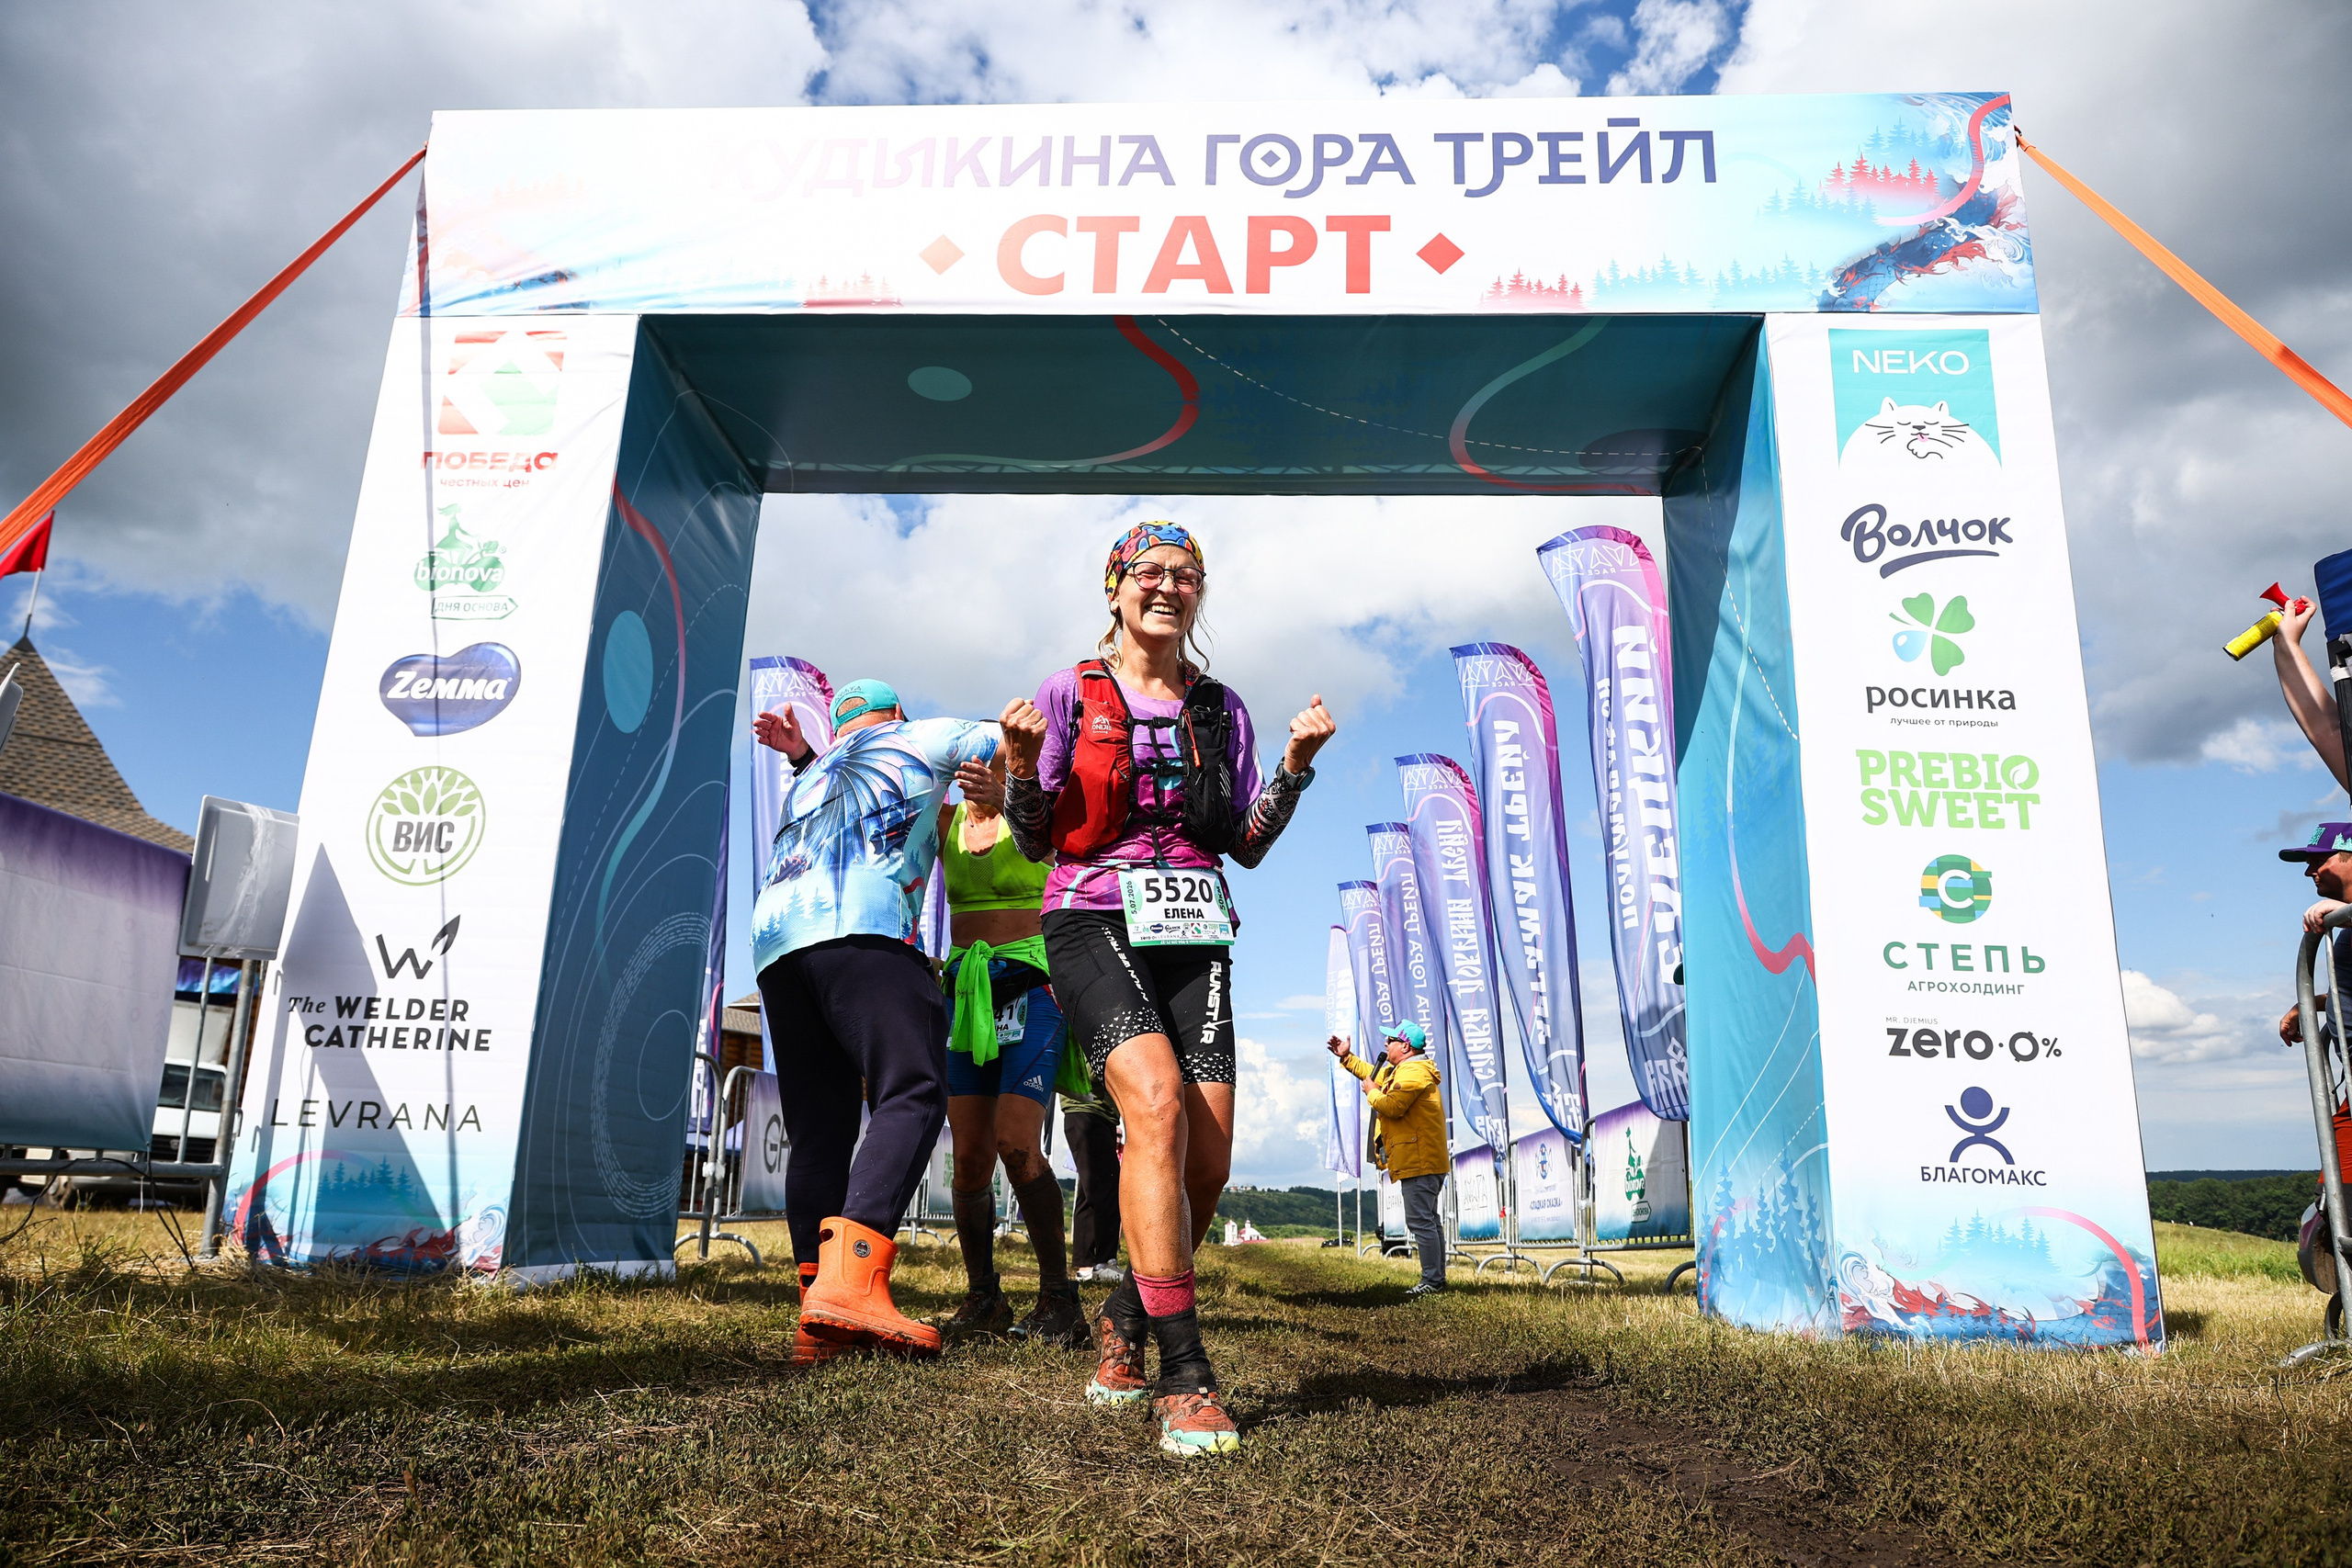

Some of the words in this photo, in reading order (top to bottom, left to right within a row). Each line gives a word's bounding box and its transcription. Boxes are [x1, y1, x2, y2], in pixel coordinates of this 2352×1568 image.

[1205, 133, 1416, 199] ГОРА
[1433, 117, 1717, 198] ТРЕЙЛ
[996, 213, 1392, 295] СТАРТ
[1852, 349, 1970, 375] NEKO
[440, 478, 498, 488] честных
[503, 479, 530, 489] цен
[1840, 502, 2014, 564] Волчок
[415, 560, 504, 582] bionova
[435, 601, 460, 613] ДНЯ
[463, 602, 509, 613] ОСНОВА
[1865, 685, 2017, 714] росинка
[1890, 716, 1931, 728] лучшее
[1949, 719, 1999, 728] природы
[1855, 749, 2040, 791] PREBIO
[1860, 787, 2041, 830] SWEET
[392, 820, 456, 853] ВИС
[1145, 877, 1214, 903] 5520
[1164, 908, 1205, 919] ЕЛЕНА
[1117, 952, 1132, 973] WE
[1883, 941, 2046, 974] СТЕПЬ
[1907, 980, 2025, 996] АГРОХОЛДИНГ
[288, 996, 326, 1013] The
[334, 996, 469, 1021] WELDER
[1885, 1016, 1901, 1024] MR.
[1904, 1017, 1939, 1025] DJEMIUS
[304, 1024, 492, 1052] CATHERINE
[1023, 1078, 1045, 1093] adidas
[269, 1099, 482, 1133] LEVRANA
[1920, 1166, 2047, 1187] БЛАГОМАКС
